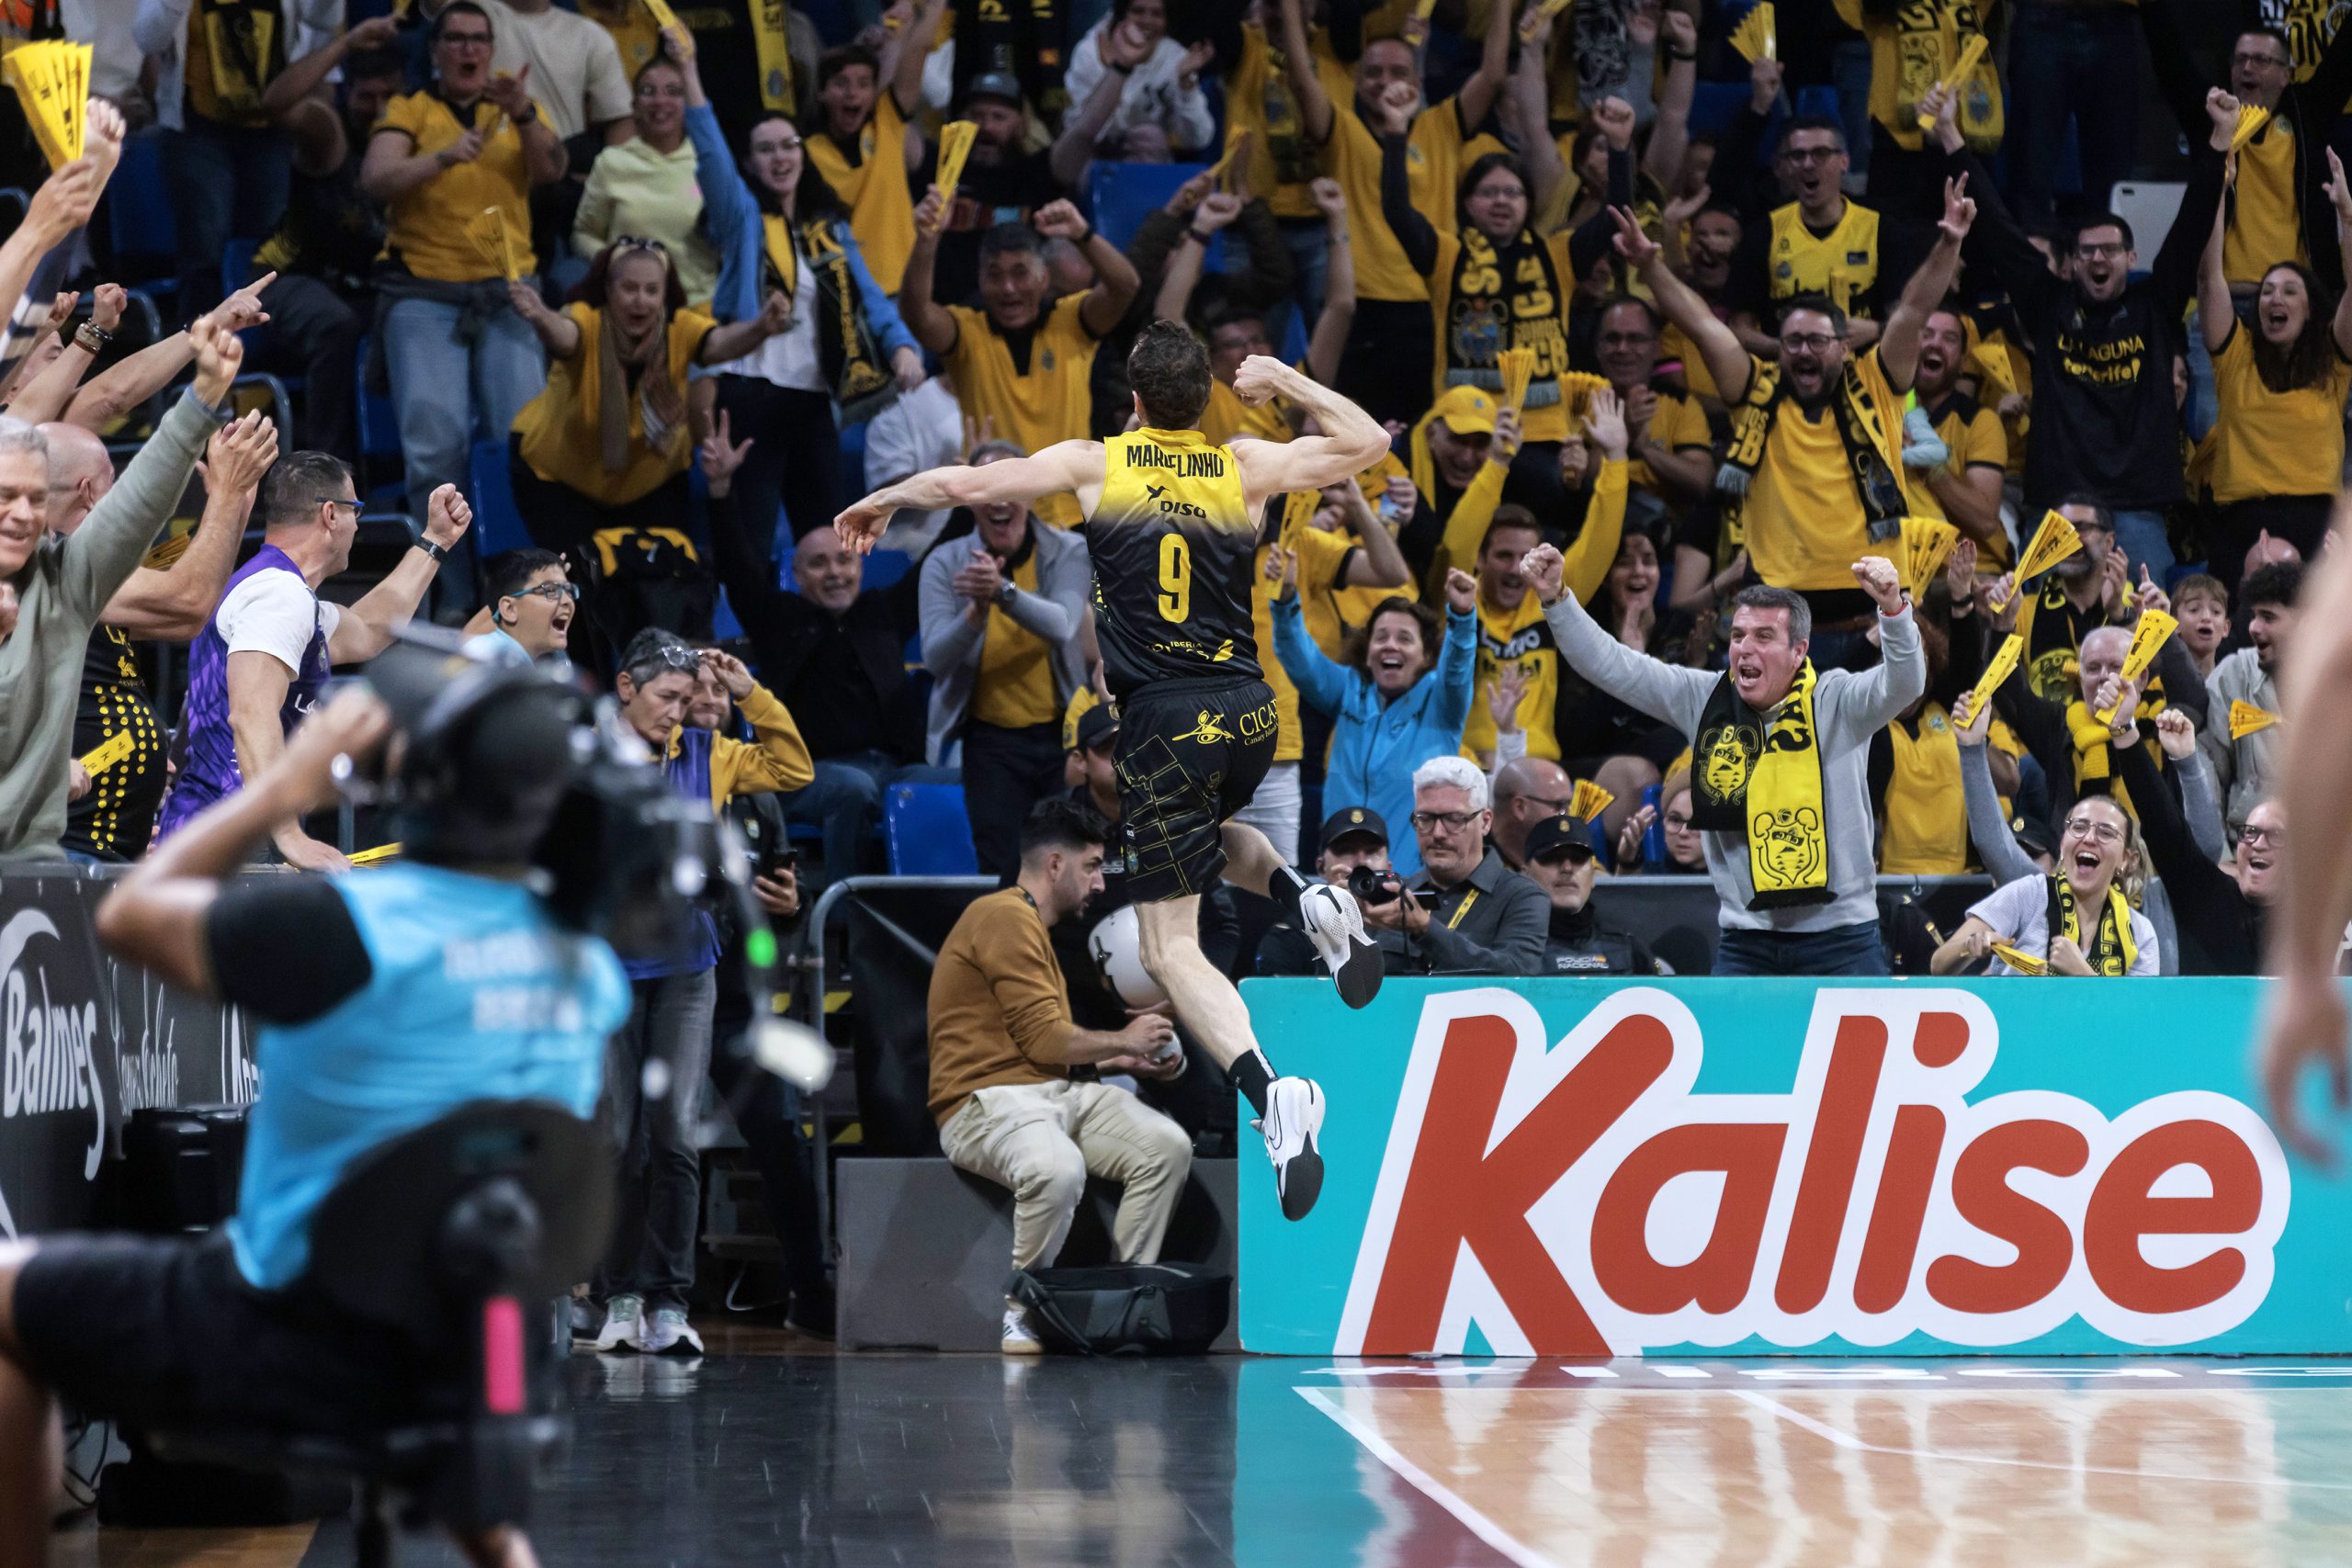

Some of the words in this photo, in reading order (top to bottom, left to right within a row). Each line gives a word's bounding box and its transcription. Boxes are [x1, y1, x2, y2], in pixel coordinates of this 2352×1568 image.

[1158, 533, 1192, 624] 9
[4, 965, 105, 1181] Balmes
[1361, 1010, 2264, 1357] Kalise
